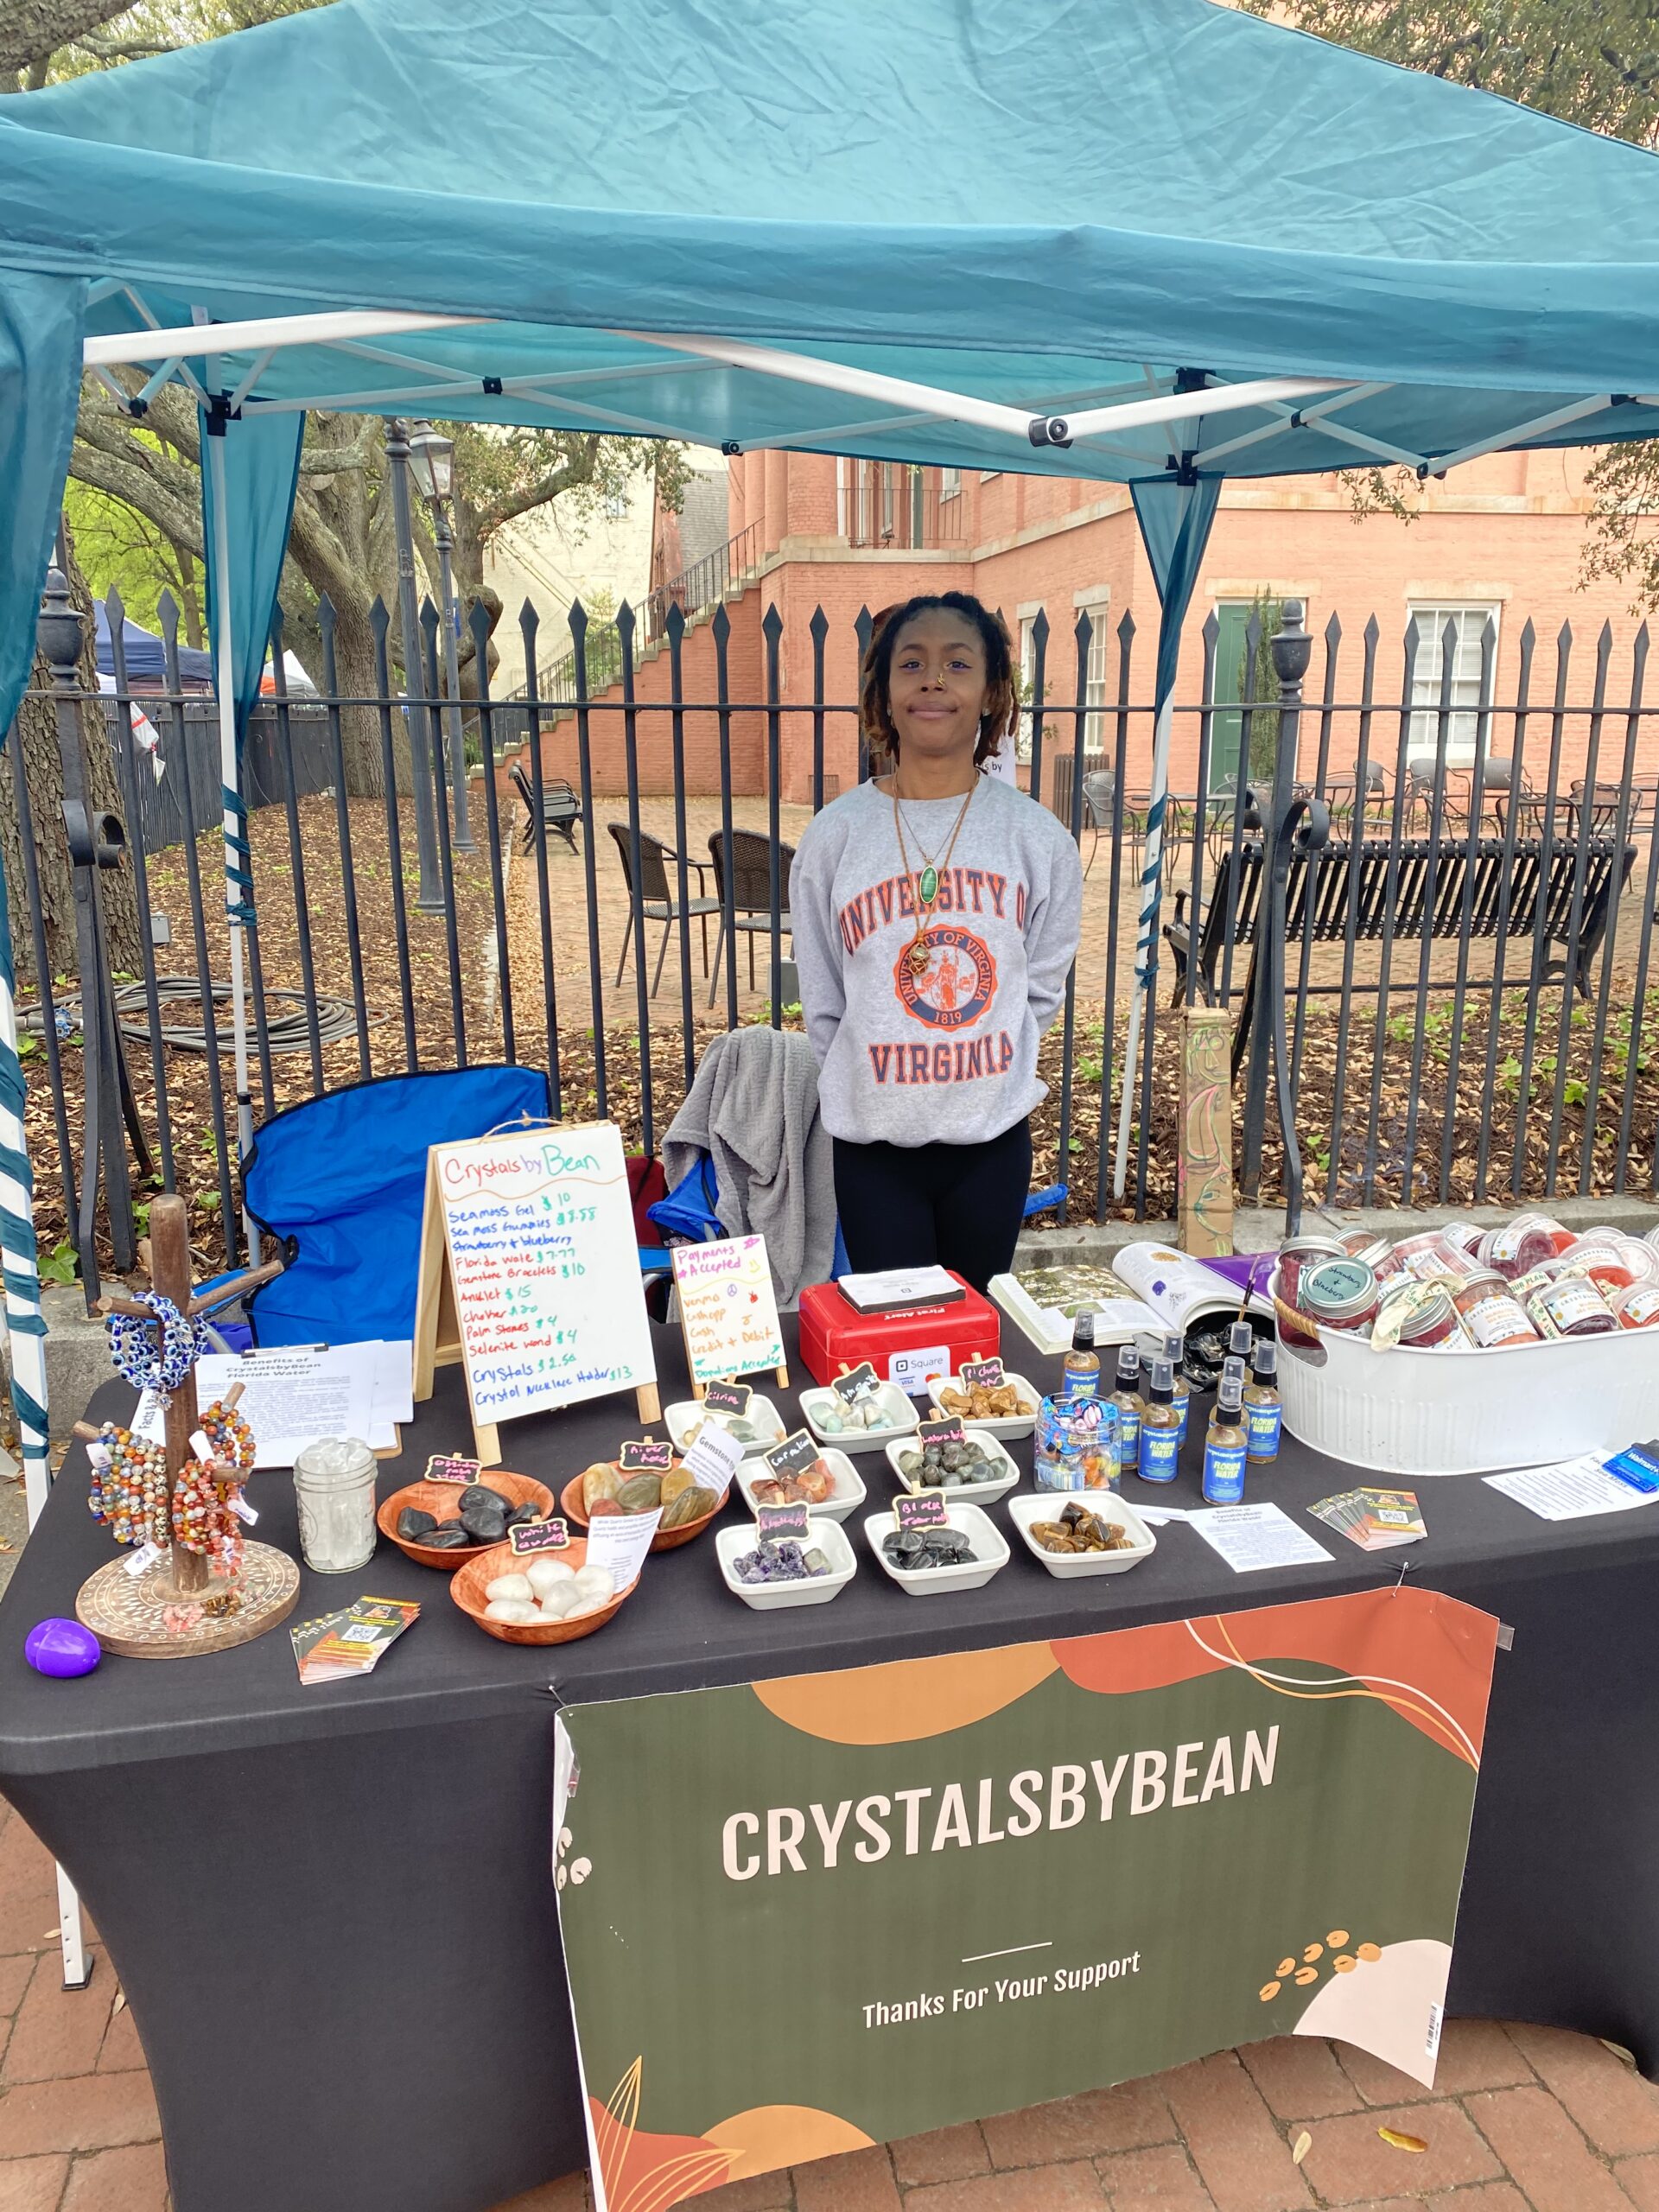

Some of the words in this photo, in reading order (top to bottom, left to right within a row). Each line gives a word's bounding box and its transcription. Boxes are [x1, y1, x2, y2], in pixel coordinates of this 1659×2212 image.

[839, 867, 1007, 957] UNIVESITY
[944, 931, 964, 944] OF
[966, 939, 992, 1001] VIRGINIA
[934, 1011, 963, 1024] 1819
[868, 1030, 1014, 1085] VIRGINIA
[445, 1159, 521, 1186] Crystals
[520, 1154, 542, 1174] by
[541, 1144, 601, 1176] Bean
[677, 1245, 734, 1265] Payments
[911, 1357, 944, 1369] Square
[1072, 1382, 1096, 1392] FLORIDA
[1251, 1417, 1277, 1426] FLORIDA
[1149, 1441, 1175, 1450] FLORIDA
[1214, 1460, 1241, 1471] FLORIDA
[1628, 1452, 1654, 1471] Walmart
[1216, 1470, 1238, 1478] WATER
[721, 1724, 1281, 1882] CRYSTALSBYBEAN
[862, 1993, 944, 2028] Thanks
[952, 1986, 988, 2012] For
[995, 1975, 1048, 2002] Your
[1053, 1951, 1141, 1992] Support
